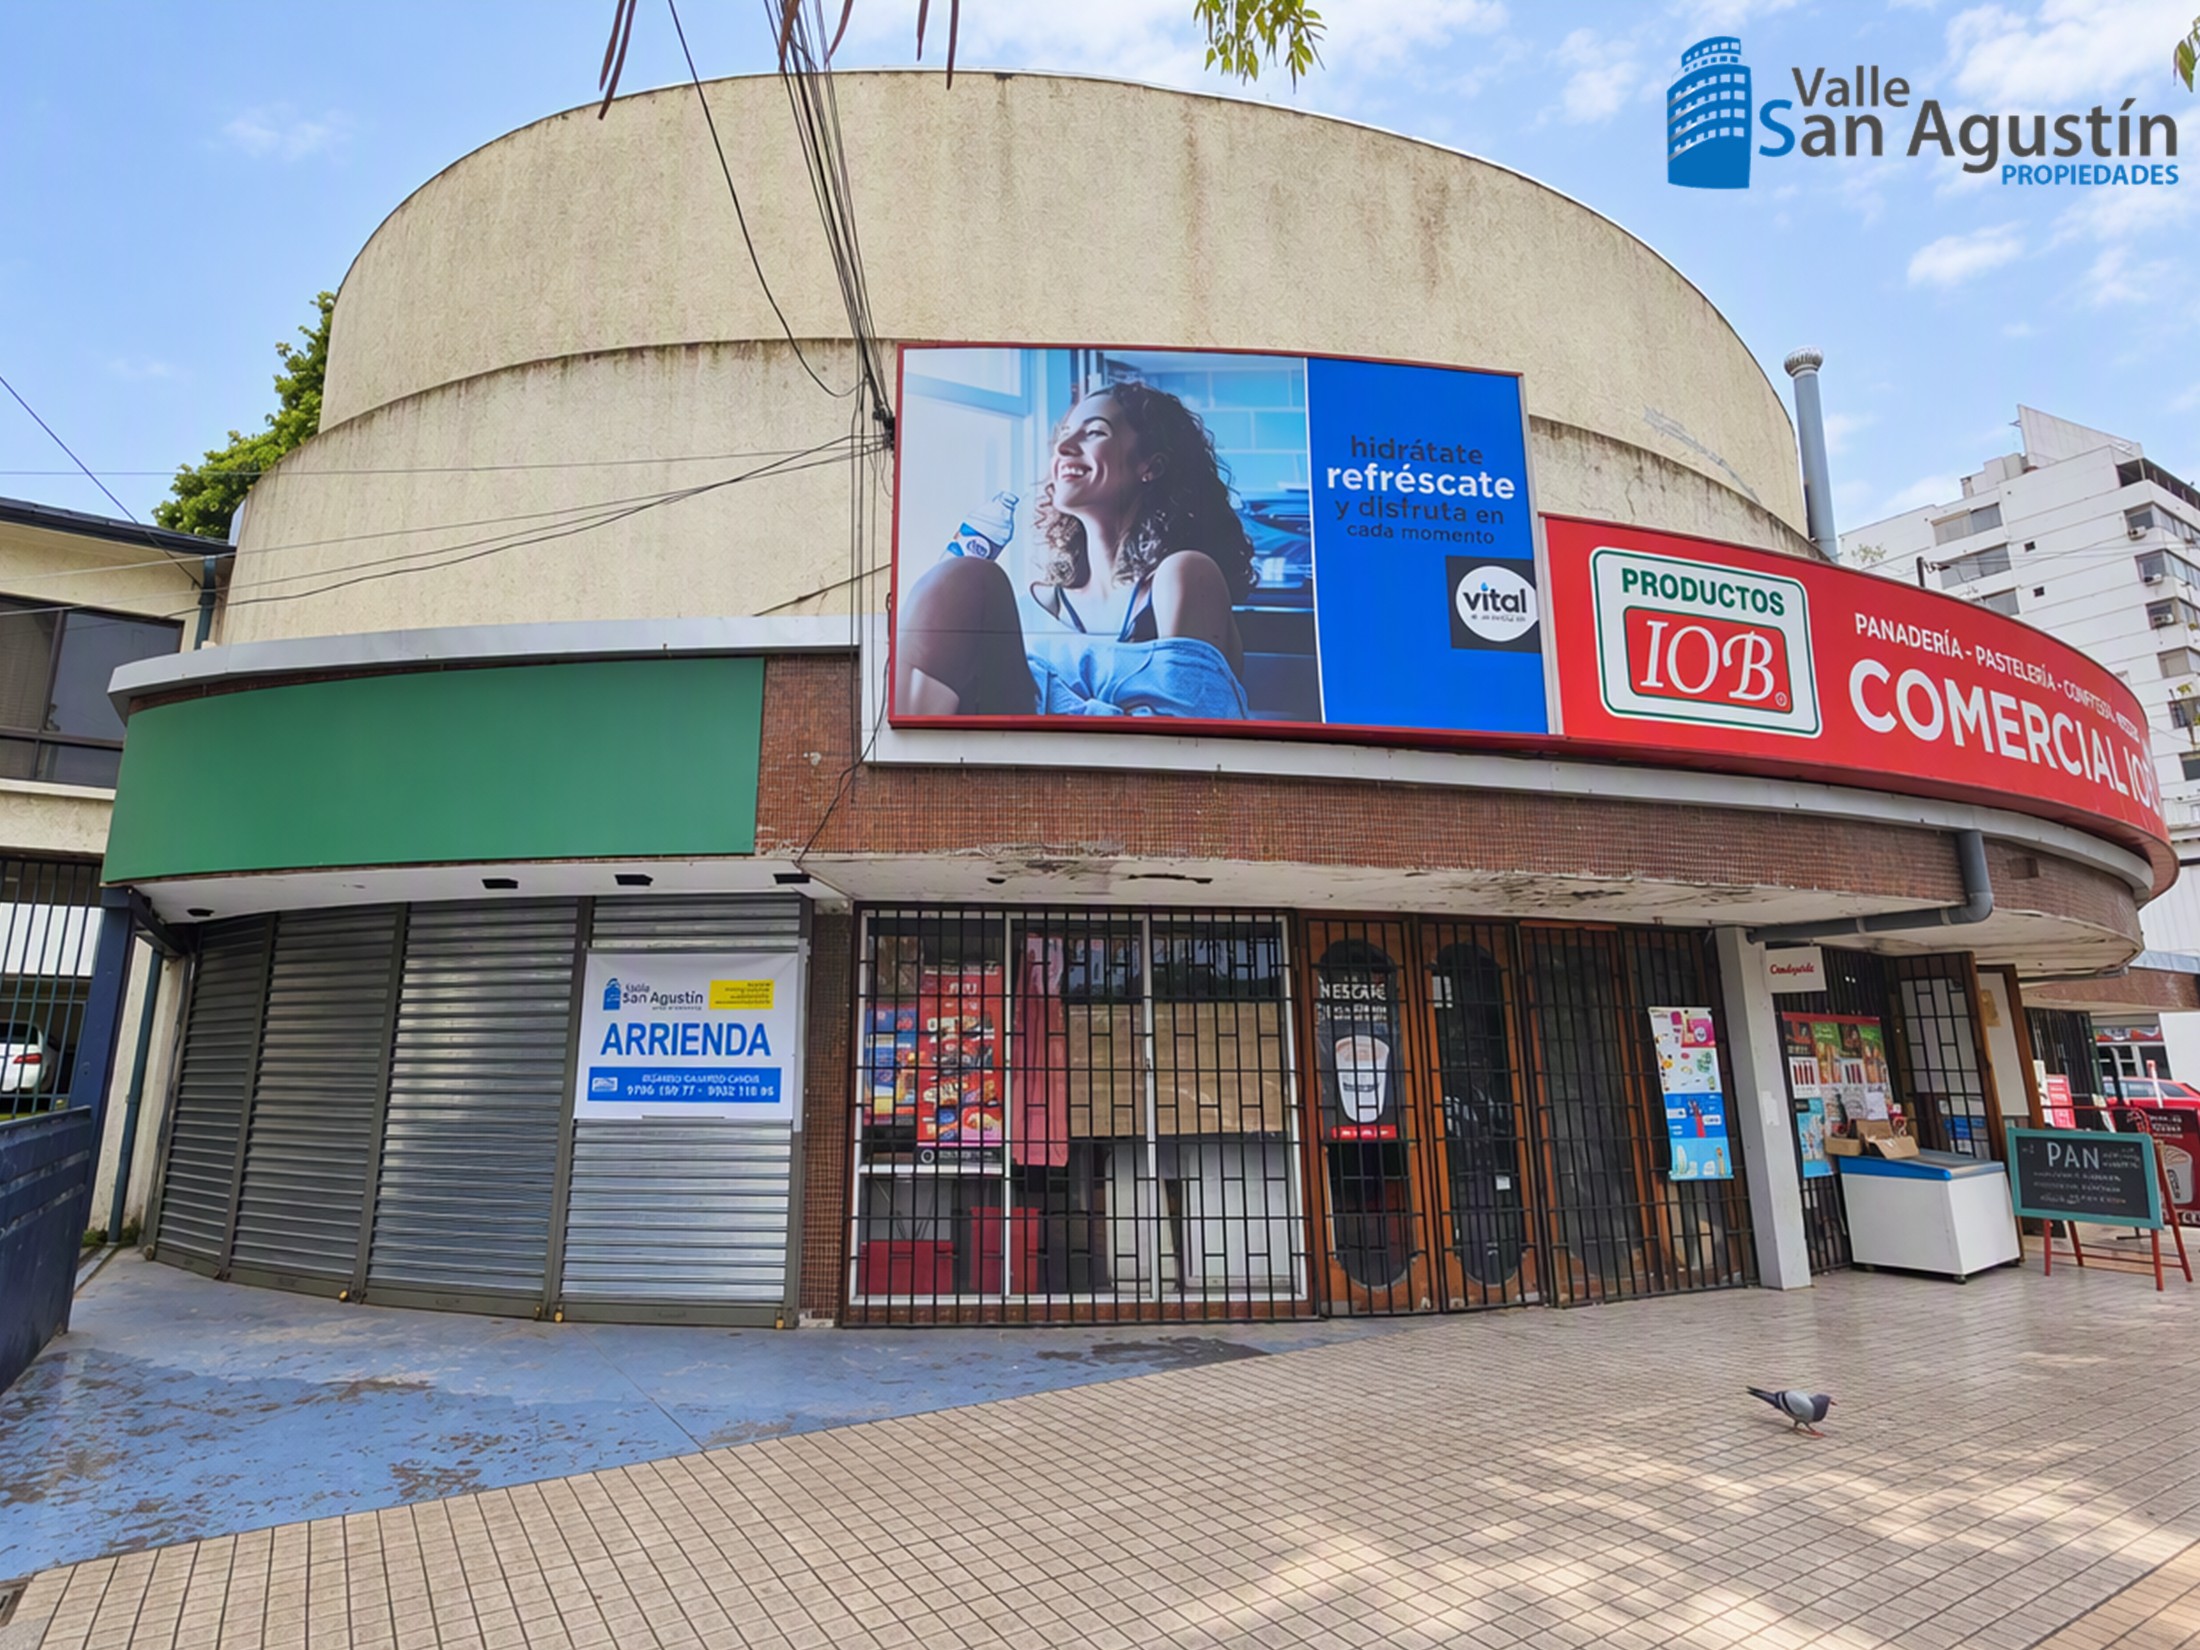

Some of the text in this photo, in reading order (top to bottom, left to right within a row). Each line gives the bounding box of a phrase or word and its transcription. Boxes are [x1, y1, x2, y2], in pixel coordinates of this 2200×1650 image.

[1351, 435, 1484, 465] hidrátate
[1326, 462, 1516, 500] refréscate
[1335, 495, 1504, 525] y disfruta en
[1346, 523, 1496, 545] cada momento
[1462, 582, 1527, 613] vital
[1621, 567, 1785, 616] PRODUCTOS
[1639, 620, 1775, 701] IOB
[1855, 612, 1964, 660] PANADERÍA
[1975, 645, 2056, 692] PASTELERÍA
[1849, 658, 2130, 797] COMERCIAL
[622, 993, 647, 1004] San
[600, 1022, 772, 1057] ARRIENDA
[2046, 1141, 2100, 1170] PAN
